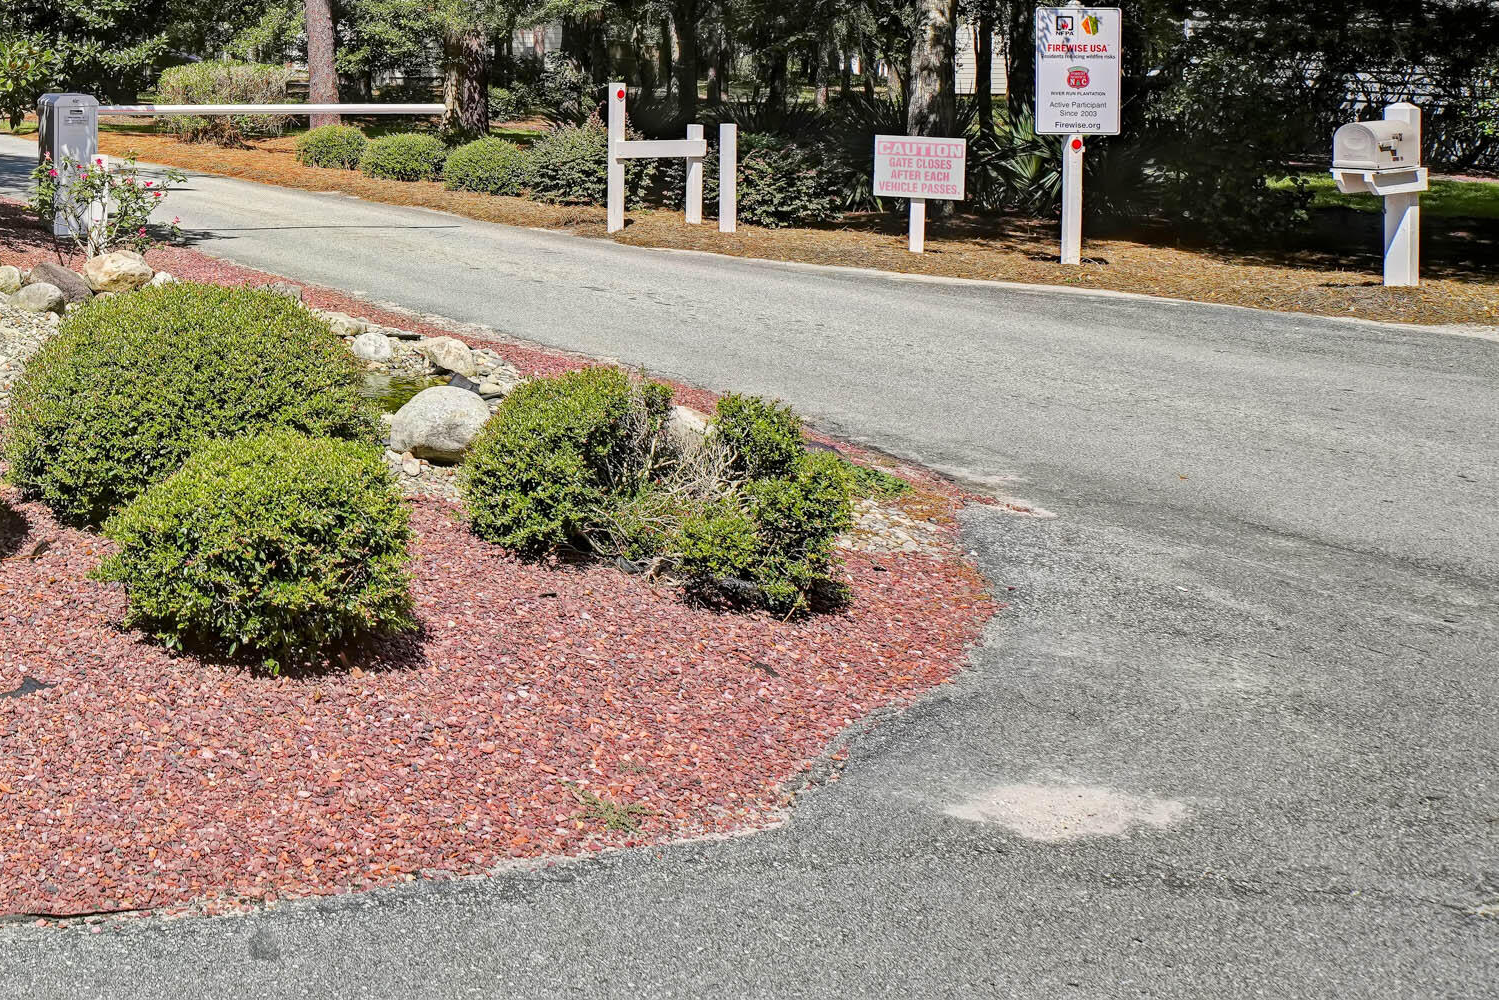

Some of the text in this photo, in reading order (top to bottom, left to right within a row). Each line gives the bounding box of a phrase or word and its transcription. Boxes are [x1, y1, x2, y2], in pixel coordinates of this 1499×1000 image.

[1047, 44, 1108, 52] FIREWISE USA
[1071, 101, 1107, 109] Participant
[1055, 121, 1101, 129] Firewise.org
[879, 142, 963, 158] CAUTION
[889, 157, 952, 170] GATE CLOSES
[891, 169, 950, 182] AFTER EACH
[879, 180, 961, 195] VEHICLE PASSES.
